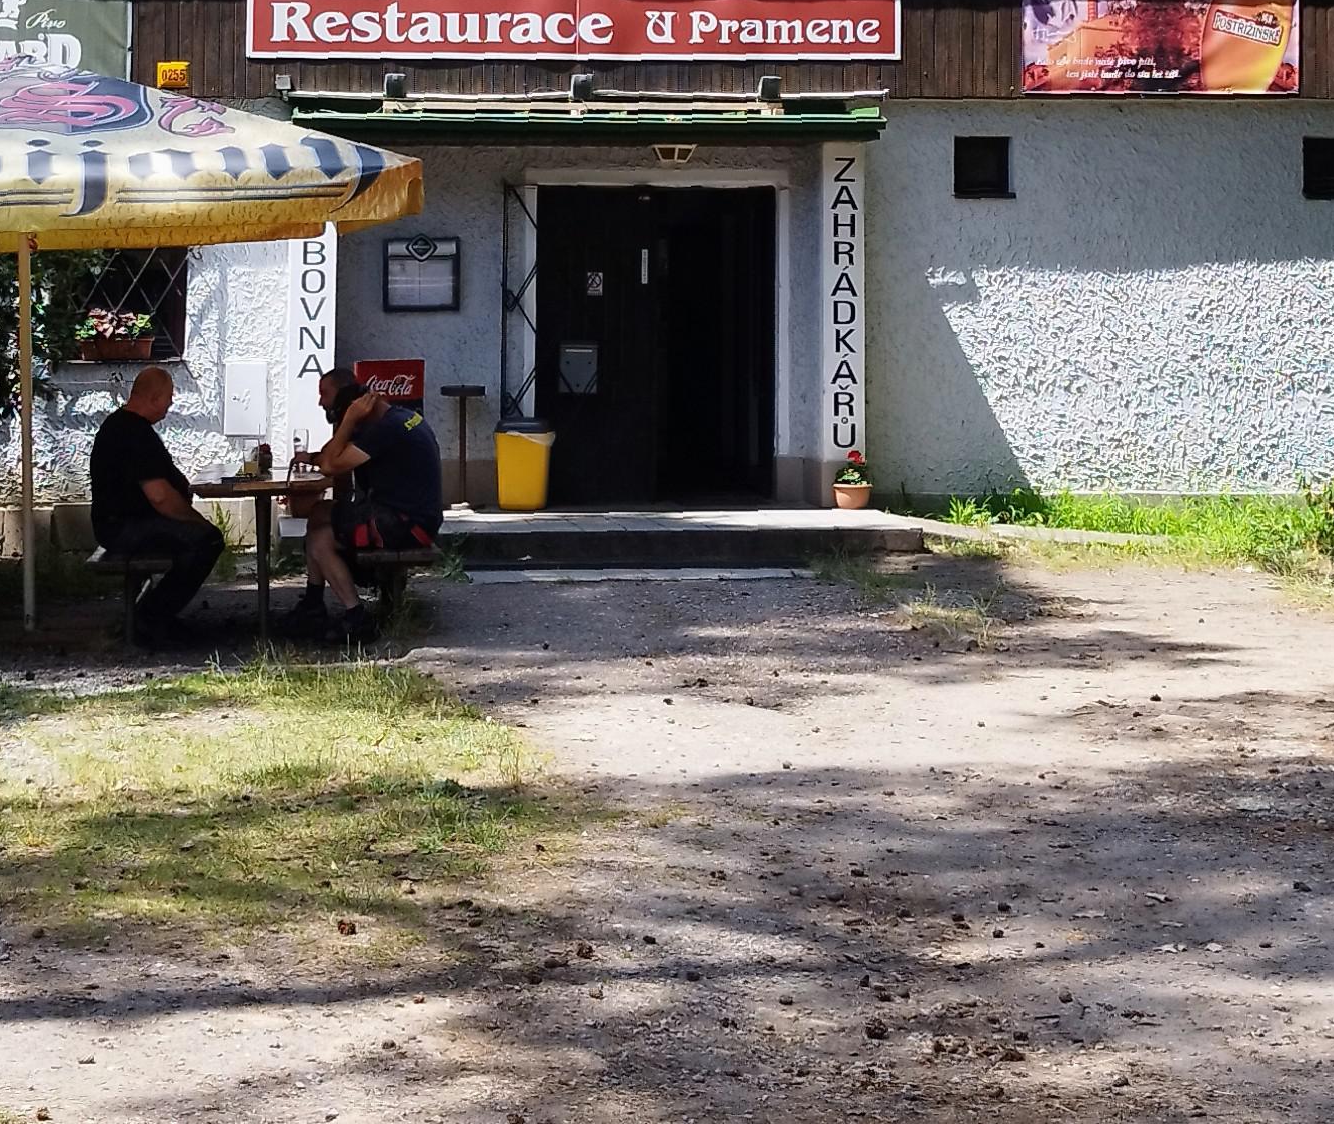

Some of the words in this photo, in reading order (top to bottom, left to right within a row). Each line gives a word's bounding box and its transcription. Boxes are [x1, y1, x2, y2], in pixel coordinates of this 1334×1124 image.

[26, 9, 66, 29] Pivo
[270, 2, 613, 44] Restaurace
[645, 11, 677, 44] U
[689, 11, 881, 44] Pramene
[162, 69, 187, 81] 0255
[831, 157, 858, 449] ZAHRÁDKÁŘŮ
